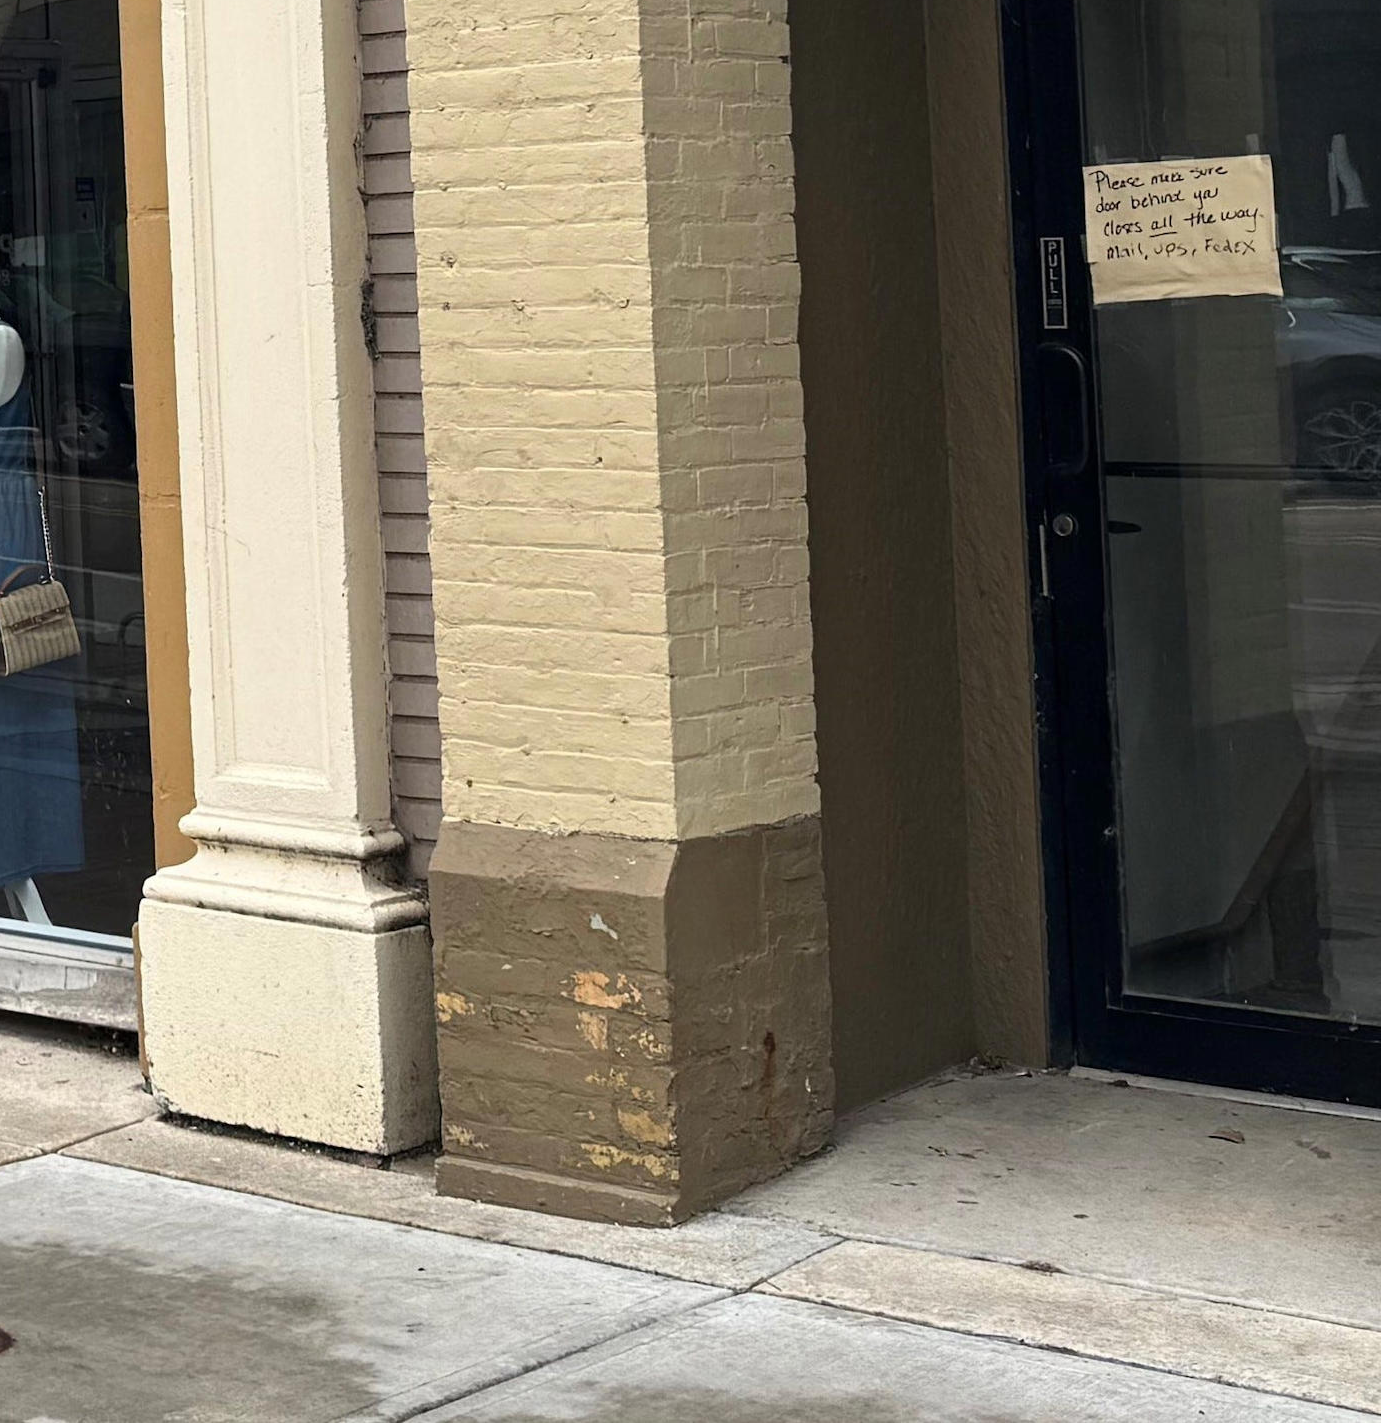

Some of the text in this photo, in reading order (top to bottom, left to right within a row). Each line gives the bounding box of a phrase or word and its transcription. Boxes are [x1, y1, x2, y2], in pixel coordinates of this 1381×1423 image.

[1089, 170, 1145, 193] Please
[1189, 165, 1228, 179] sure
[1096, 195, 1121, 213] door
[1149, 216, 1177, 231] all
[1183, 212, 1217, 227] the
[1048, 242, 1060, 294] PULL
